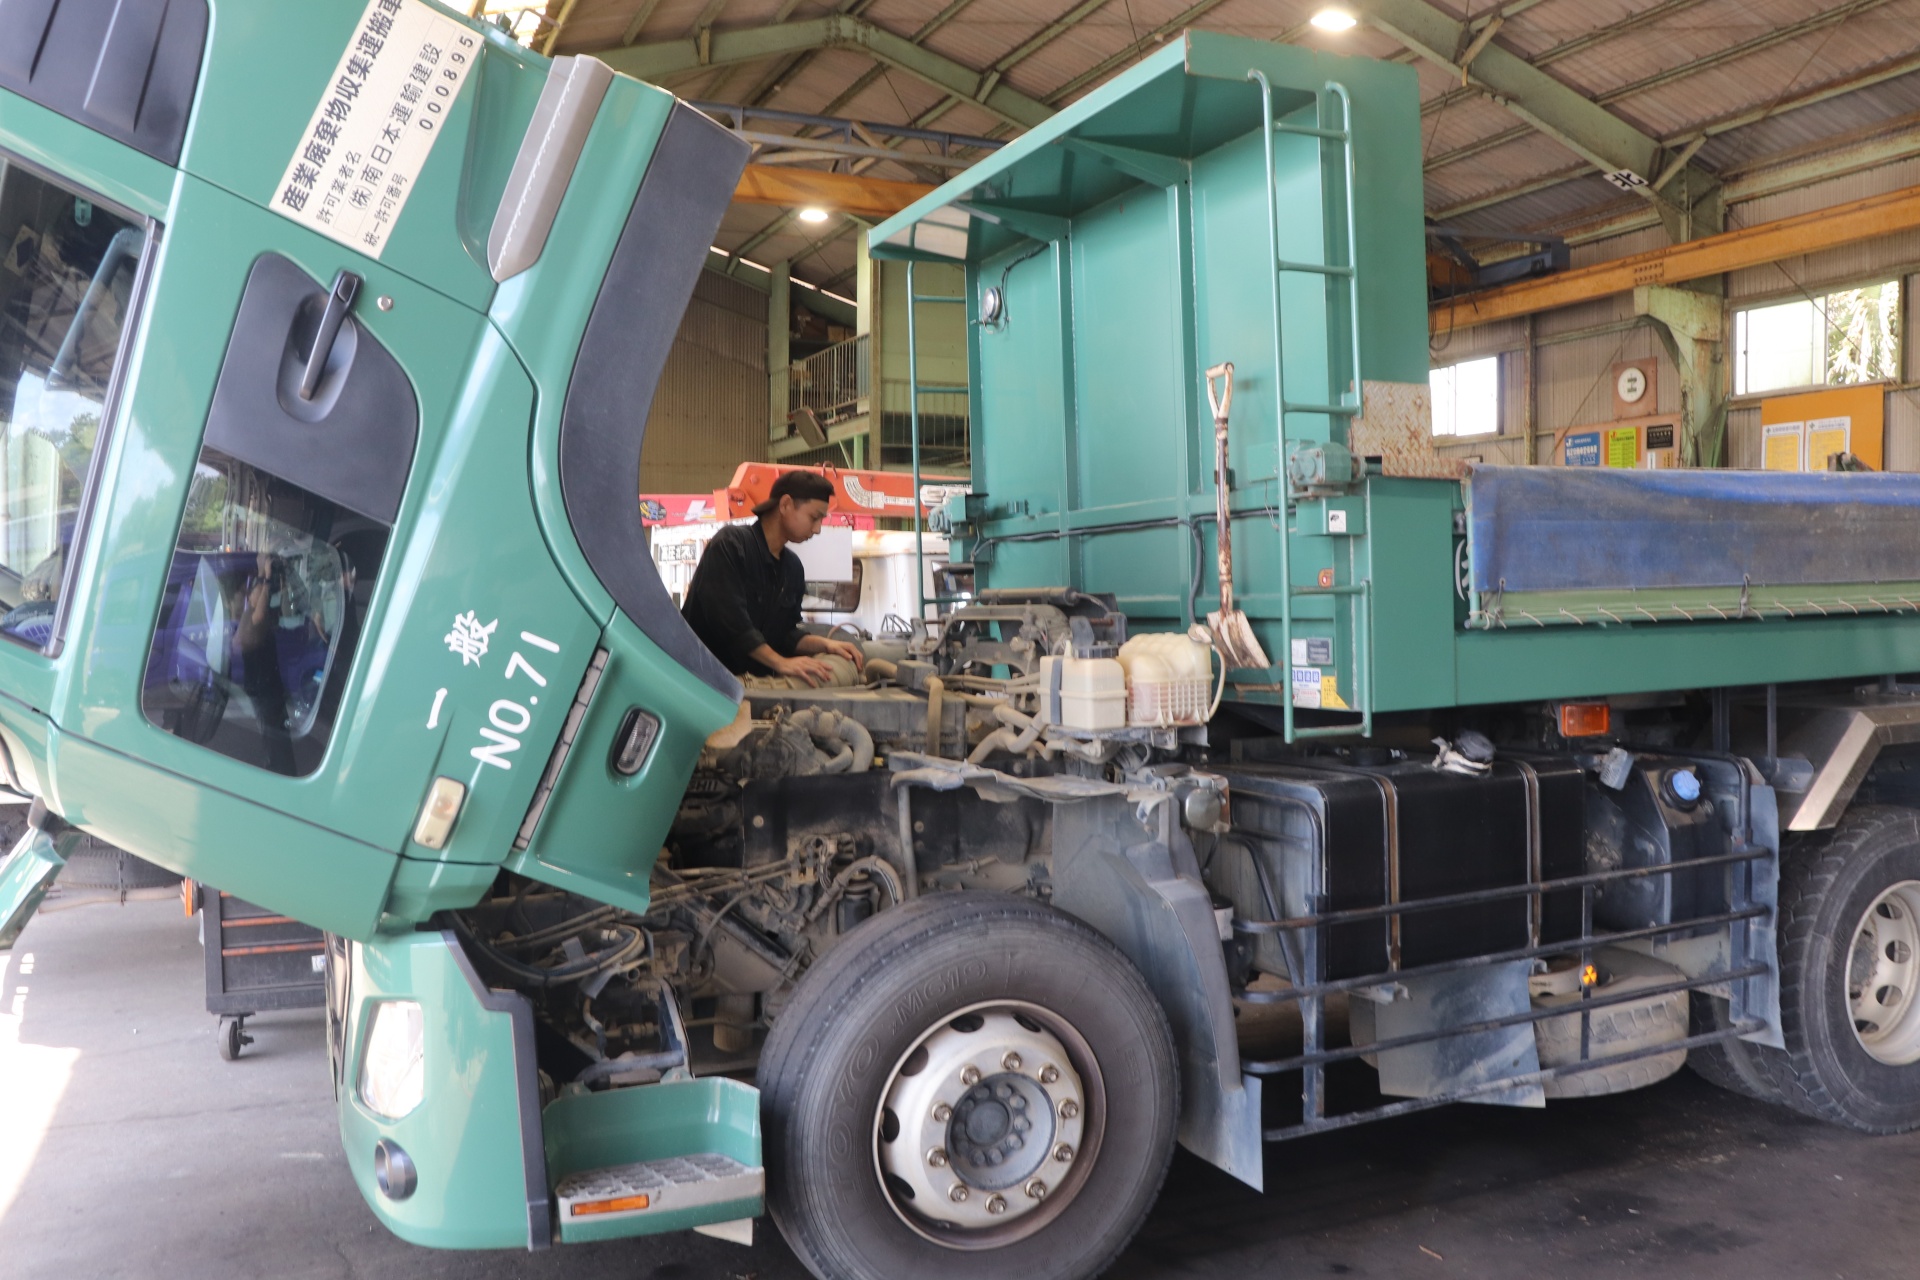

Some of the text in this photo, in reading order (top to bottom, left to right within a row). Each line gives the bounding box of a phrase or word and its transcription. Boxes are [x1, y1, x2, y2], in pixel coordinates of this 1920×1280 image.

[281, 0, 402, 212] 産業廃棄物収集運搬車
[362, 36, 474, 246] 統一許可番号 000895
[316, 149, 361, 224] 許可業者名
[1612, 172, 1644, 187] 北
[426, 610, 499, 730] 一般
[470, 631, 560, 770] NO.71
[828, 1035, 879, 1206] TOYO
